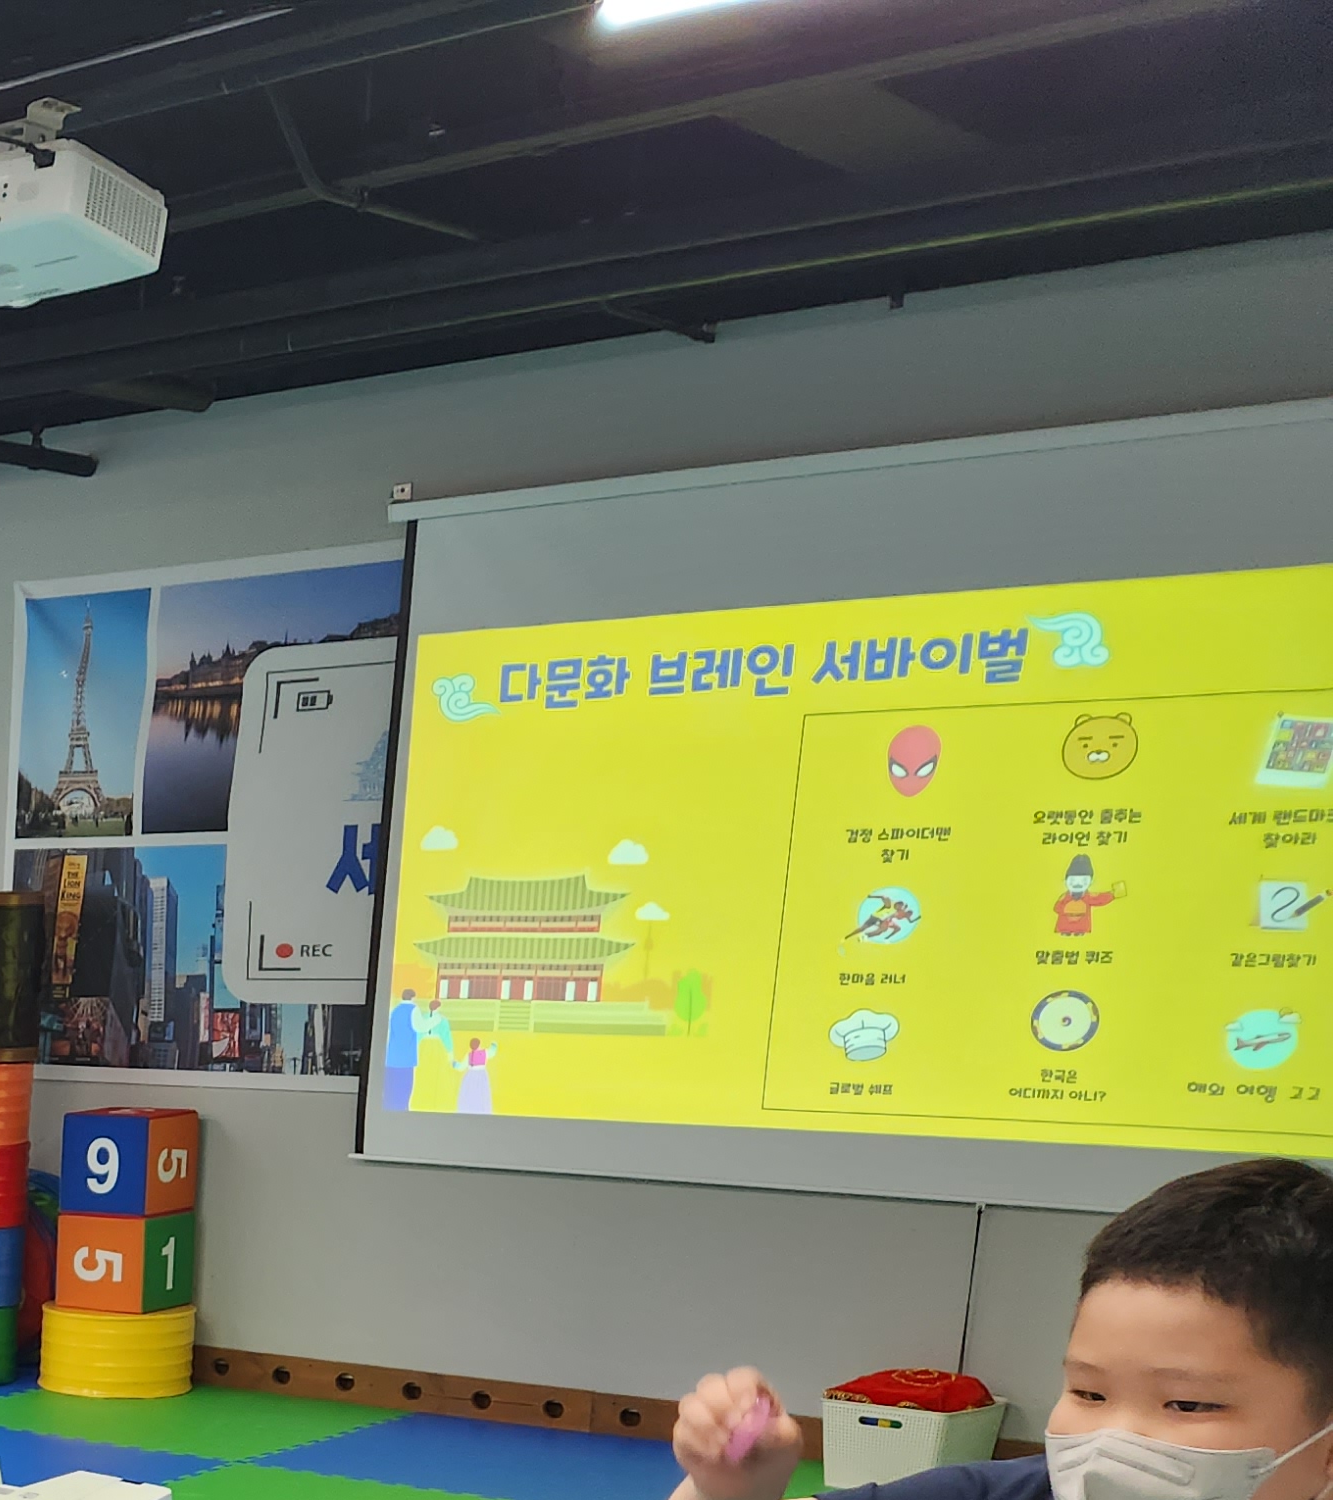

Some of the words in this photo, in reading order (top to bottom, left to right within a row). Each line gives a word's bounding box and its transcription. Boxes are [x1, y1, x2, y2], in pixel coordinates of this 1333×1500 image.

[499, 654, 631, 709] 다문화
[647, 643, 796, 697] 브레인
[812, 627, 1029, 685] 서바이벌
[1033, 809, 1094, 825] 오랫동안
[877, 826, 952, 842] 스파이더맨
[1042, 831, 1090, 847] 라이언
[1096, 831, 1128, 846] 찾기
[881, 848, 910, 863] 찾기
[300, 944, 332, 957] REC
[1035, 950, 1079, 965] 맞춤법
[1085, 950, 1113, 964] 퀴즈
[839, 973, 875, 986] 한마음
[880, 973, 907, 985] 러너
[1040, 1068, 1078, 1084] 한국은
[1008, 1087, 1064, 1101] 어디까지
[1069, 1089, 1107, 1103] 아니?
[1236, 1084, 1277, 1103] 여행
[86, 1137, 120, 1194] 9
[157, 1147, 188, 1183] 5
[73, 1246, 123, 1282] 5
[161, 1236, 176, 1290] 1
